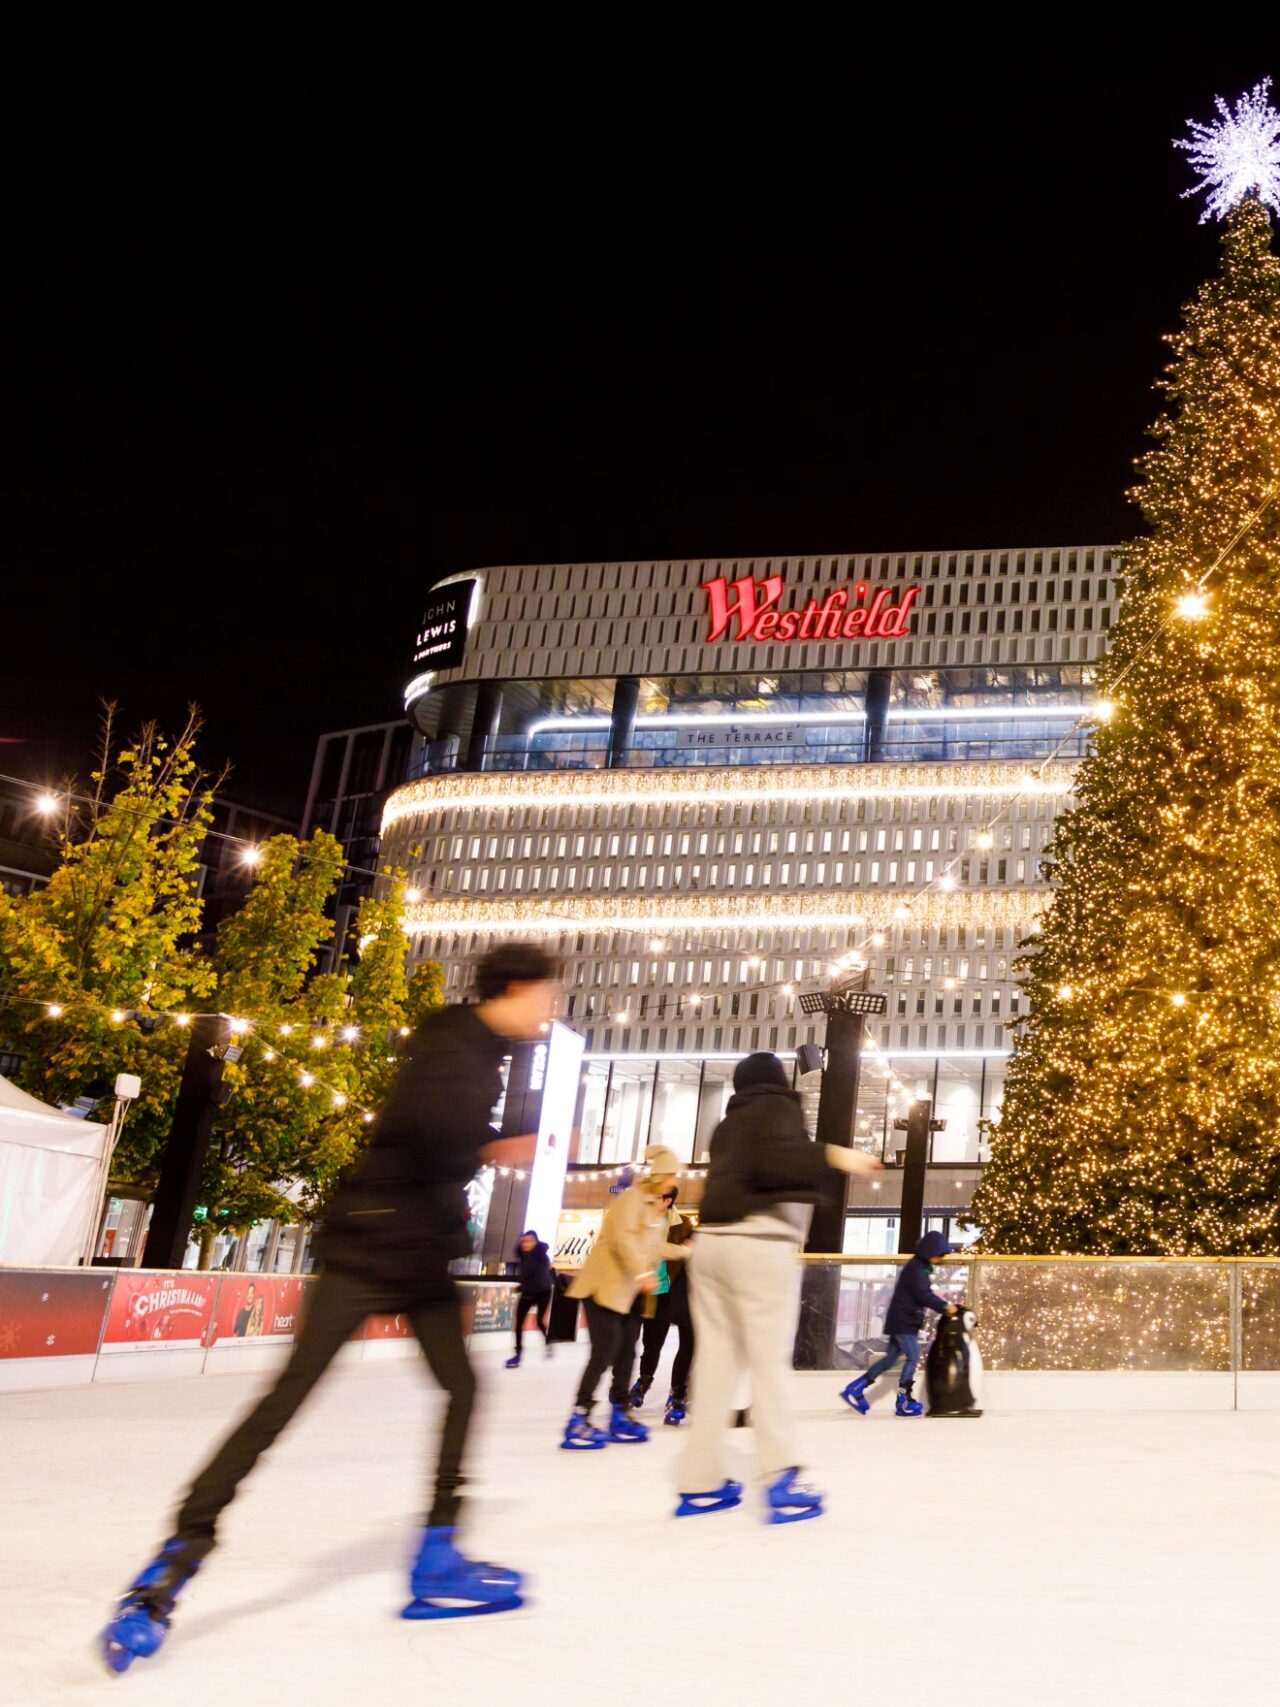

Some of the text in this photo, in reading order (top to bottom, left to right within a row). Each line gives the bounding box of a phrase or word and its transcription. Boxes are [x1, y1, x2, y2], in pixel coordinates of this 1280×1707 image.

[423, 600, 456, 624] JOHN
[702, 575, 921, 642] Westfield
[416, 619, 456, 646] LEWIS
[687, 731, 793, 743] THE TERRACE
